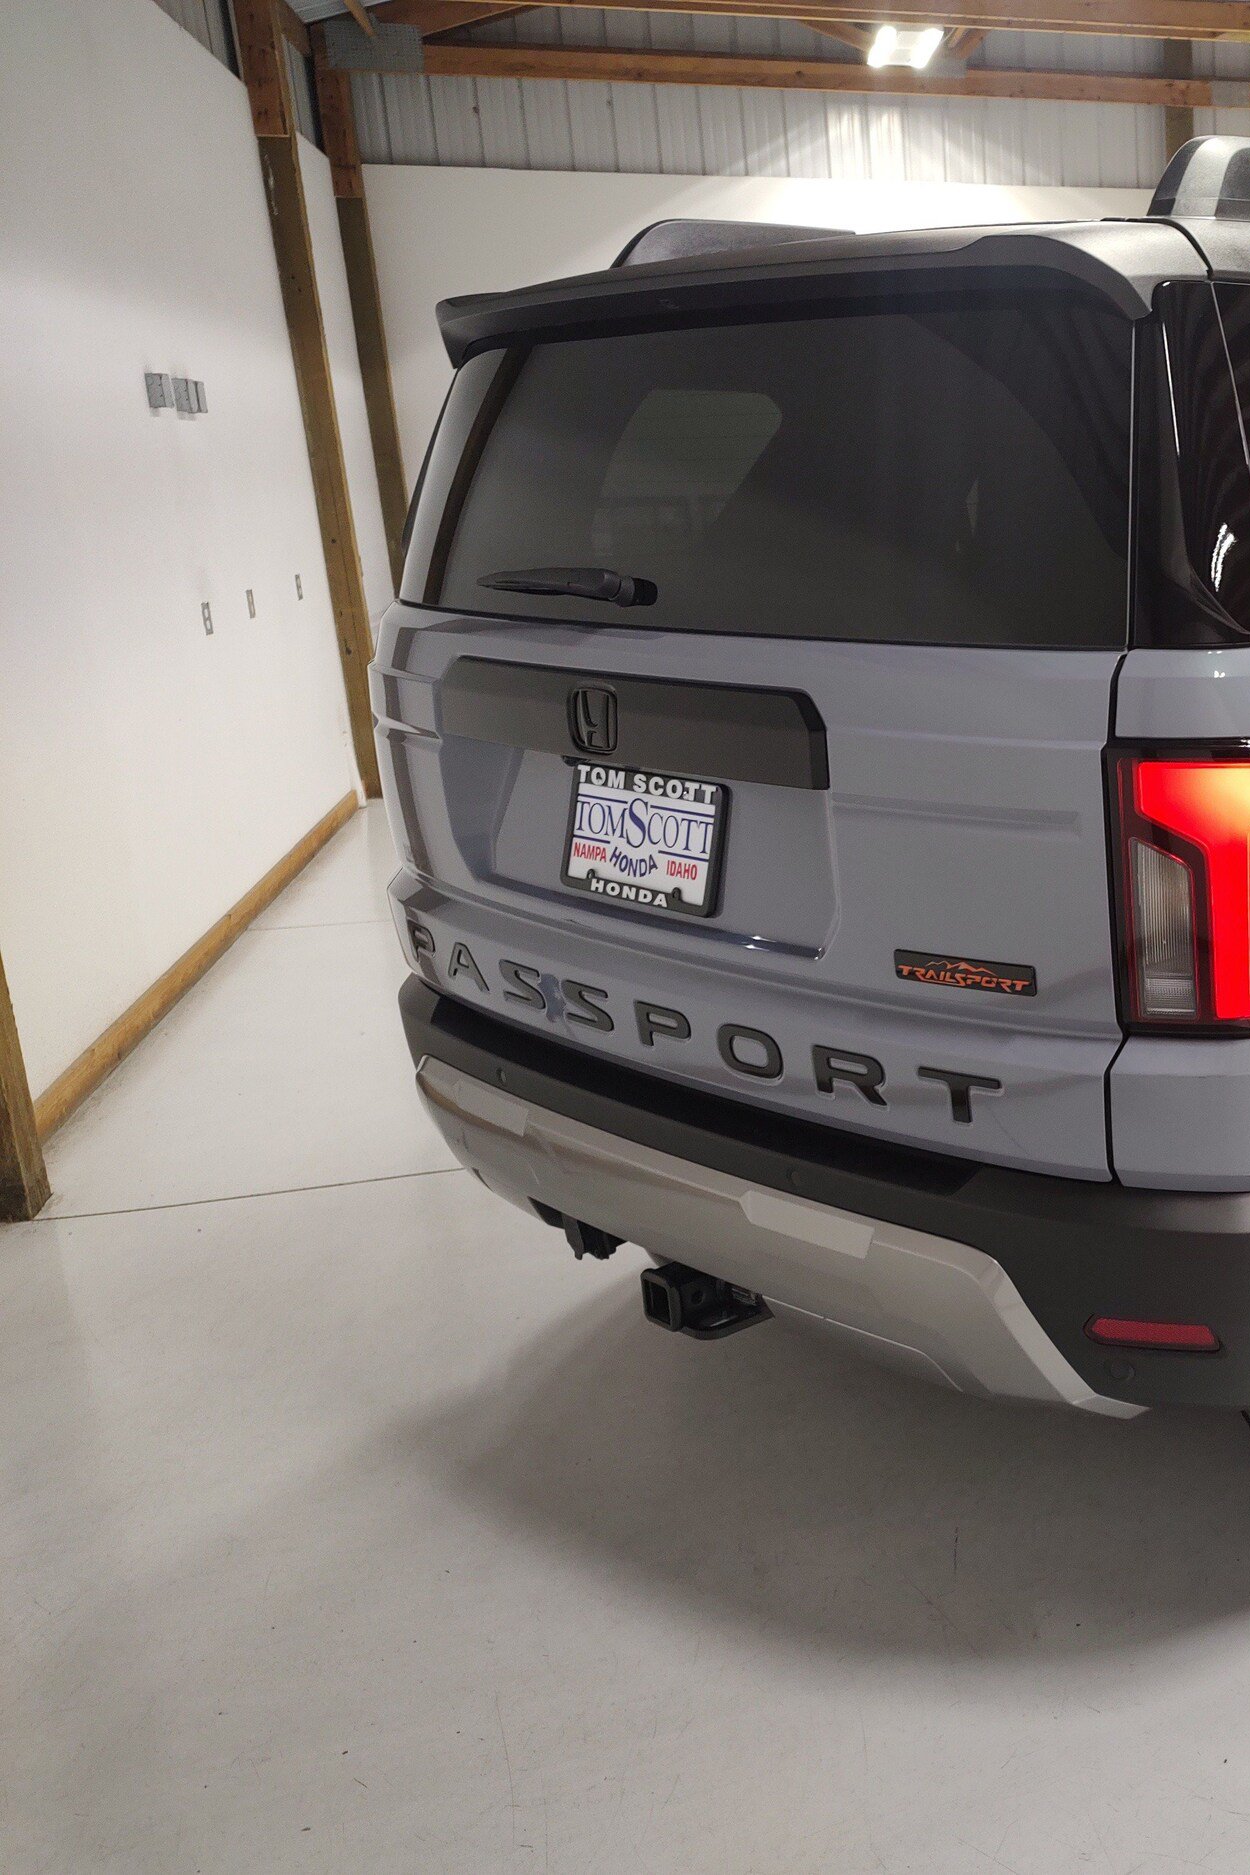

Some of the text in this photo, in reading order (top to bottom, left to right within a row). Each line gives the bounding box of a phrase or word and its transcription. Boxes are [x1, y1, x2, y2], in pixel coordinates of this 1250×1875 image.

[577, 764, 717, 804] TOM SCOTT
[573, 842, 698, 881] NAMPA HONDA IDAHO
[590, 878, 668, 908] HONDA
[898, 964, 1030, 993] TRAILSPORT
[407, 918, 1001, 1124] PASSPORT
